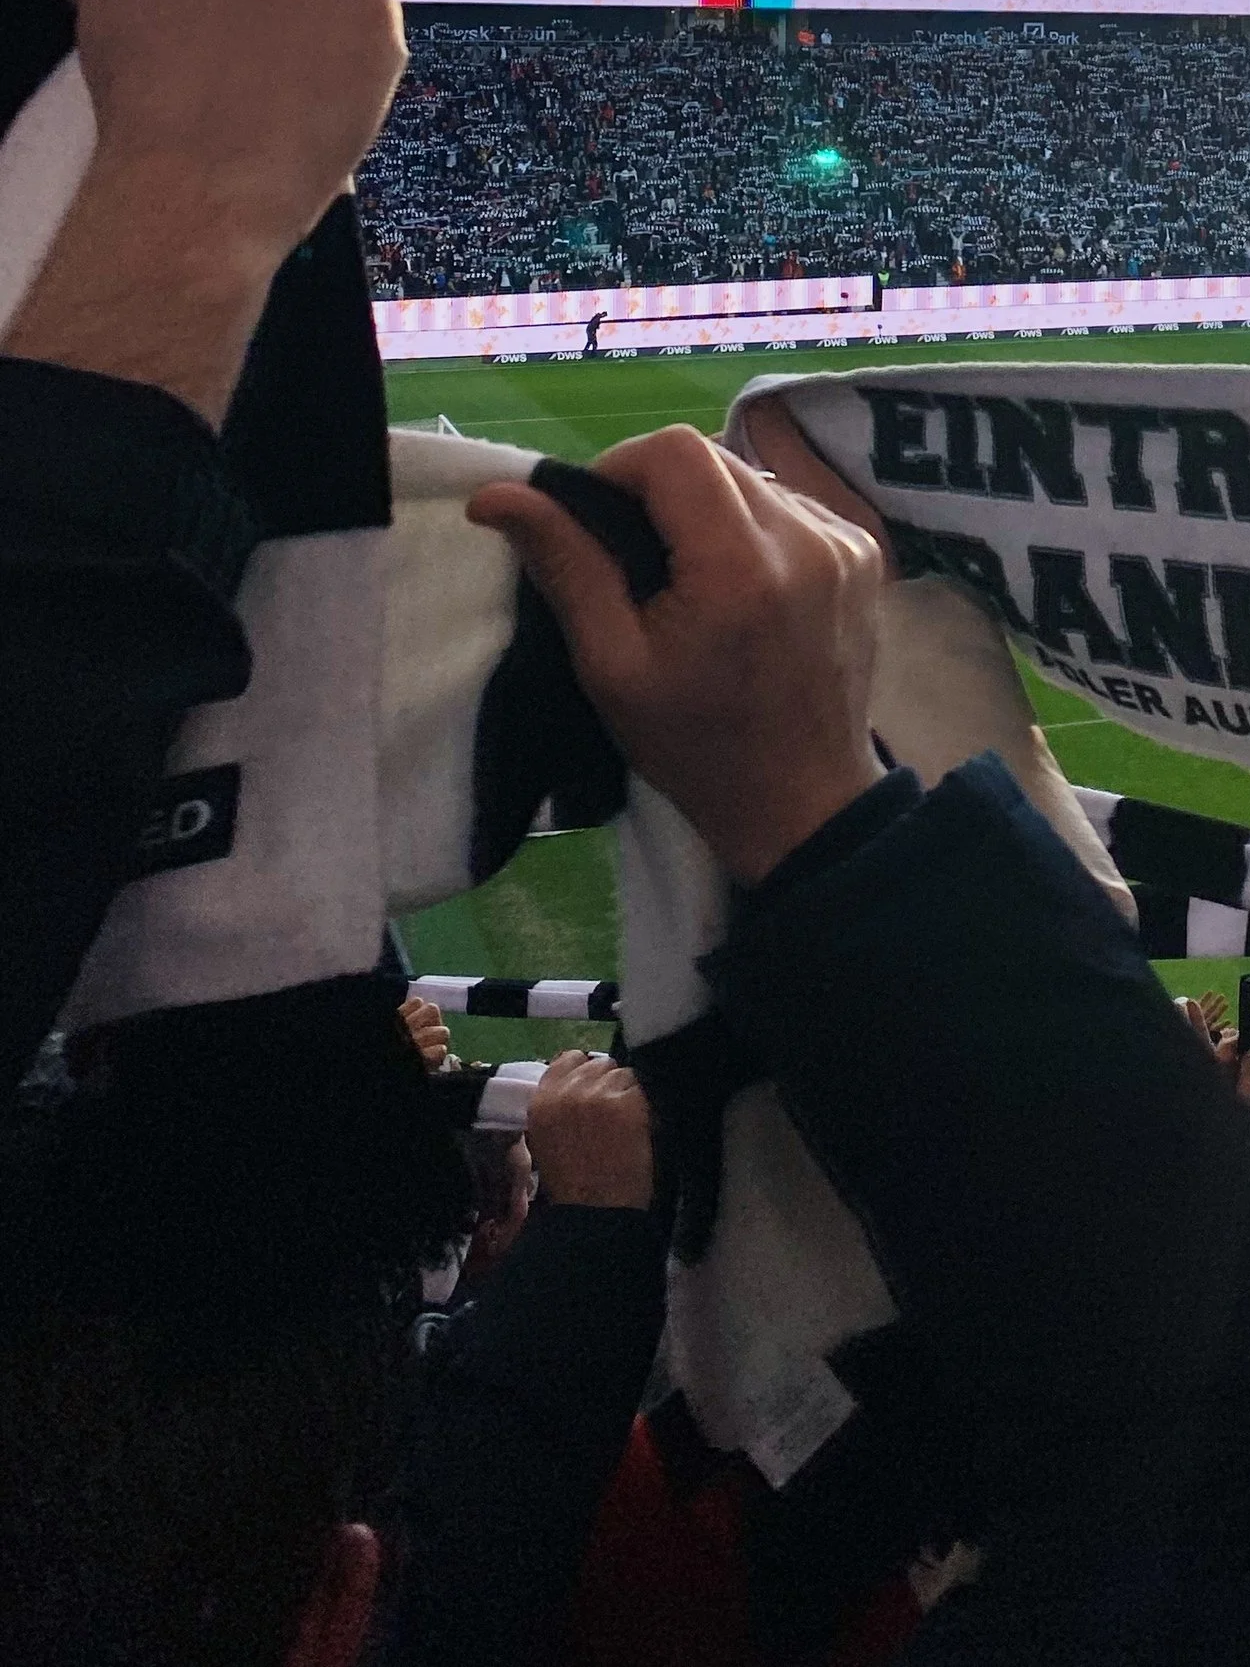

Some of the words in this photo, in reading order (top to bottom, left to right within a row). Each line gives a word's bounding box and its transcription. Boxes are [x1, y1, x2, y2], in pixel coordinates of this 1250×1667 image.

[1049, 31, 1080, 45] Park
[875, 335, 898, 345] DWS
[924, 333, 947, 342] DWS
[823, 338, 848, 347] DWS
[667, 346, 691, 355] DWS
[720, 343, 745, 352] DWS
[558, 352, 583, 361] DWS
[613, 349, 638, 358] DWS
[502, 354, 527, 363] DWS
